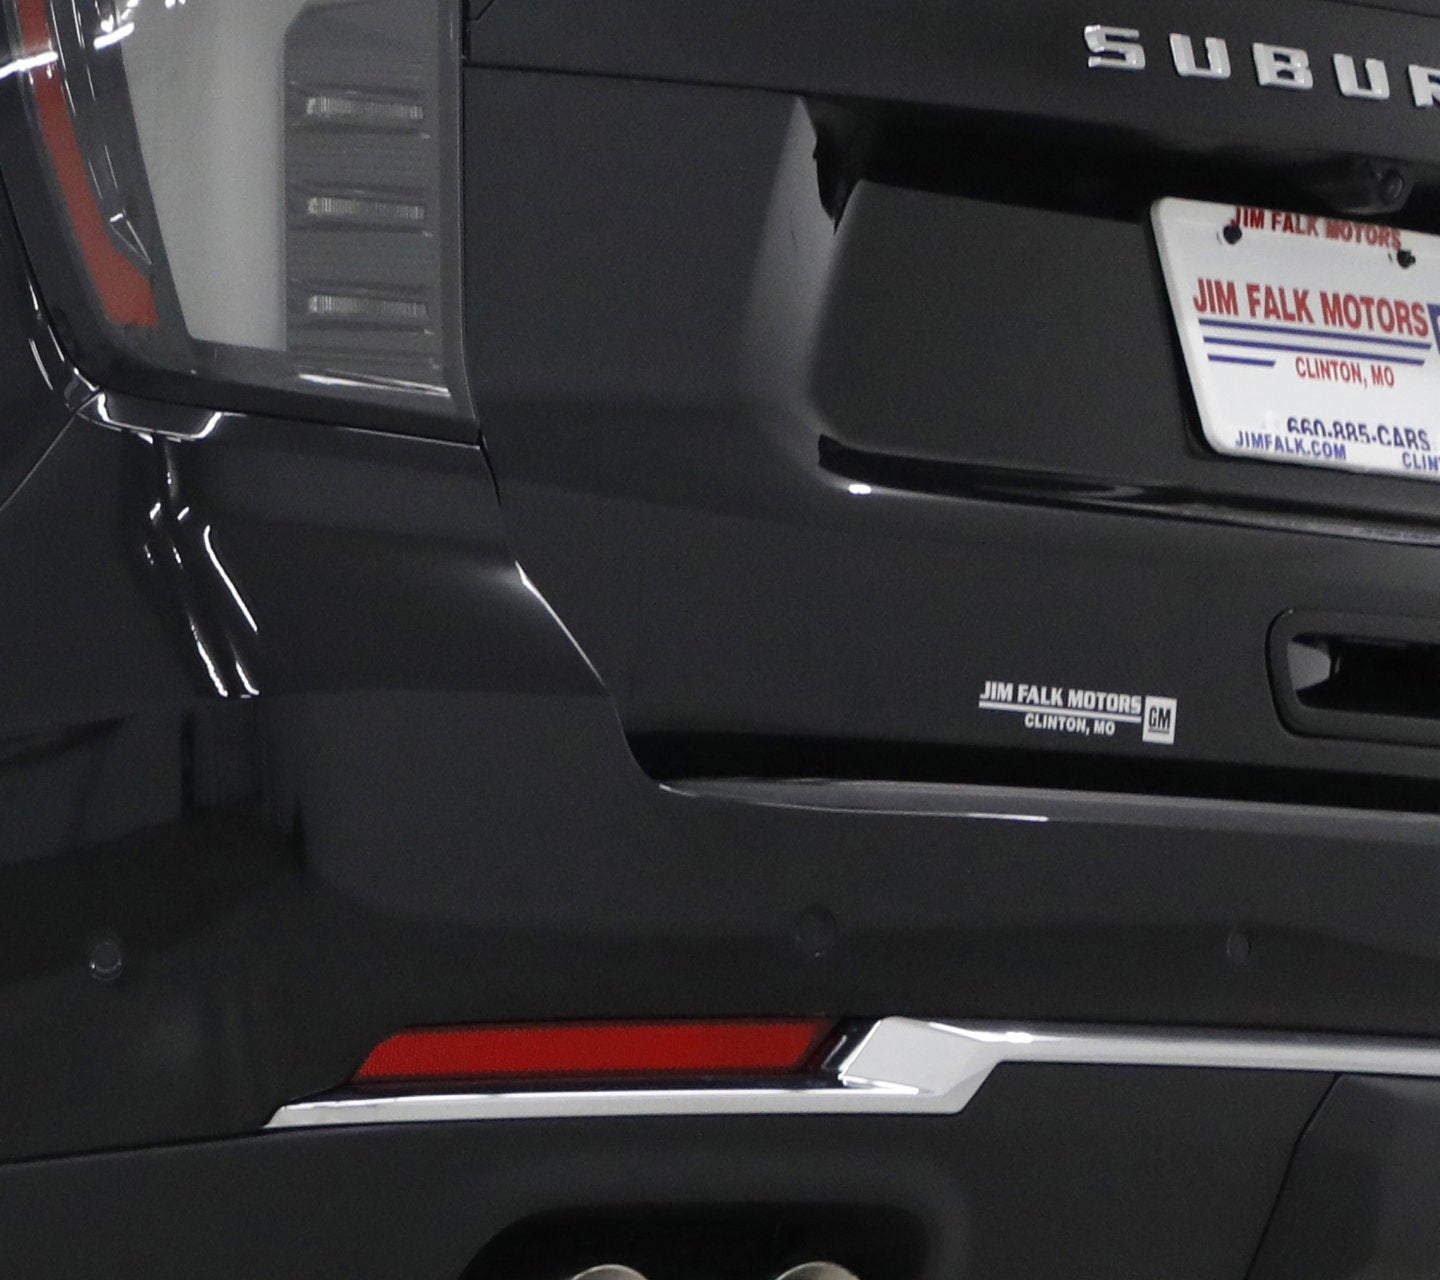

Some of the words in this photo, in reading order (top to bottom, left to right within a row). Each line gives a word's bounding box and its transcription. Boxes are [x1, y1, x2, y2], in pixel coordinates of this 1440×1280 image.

[1231, 205, 1265, 229] JIM
[1271, 210, 1319, 238] FALK
[1325, 217, 1401, 251] MOTORS
[1193, 277, 1240, 316] JIM
[1246, 284, 1316, 325] FALK
[1320, 291, 1430, 338] MOTORS
[1295, 356, 1368, 390] CLINTON,
[1371, 364, 1396, 389] MO
[1235, 430, 1347, 461] JIMFALK.COM
[980, 680, 1014, 703] JIM
[1017, 683, 1064, 707] FALK
[1067, 688, 1142, 715] MOTORS
[1024, 713, 1091, 737] CLINTON,
[1093, 720, 1116, 736] MO
[1148, 706, 1171, 730] GM
